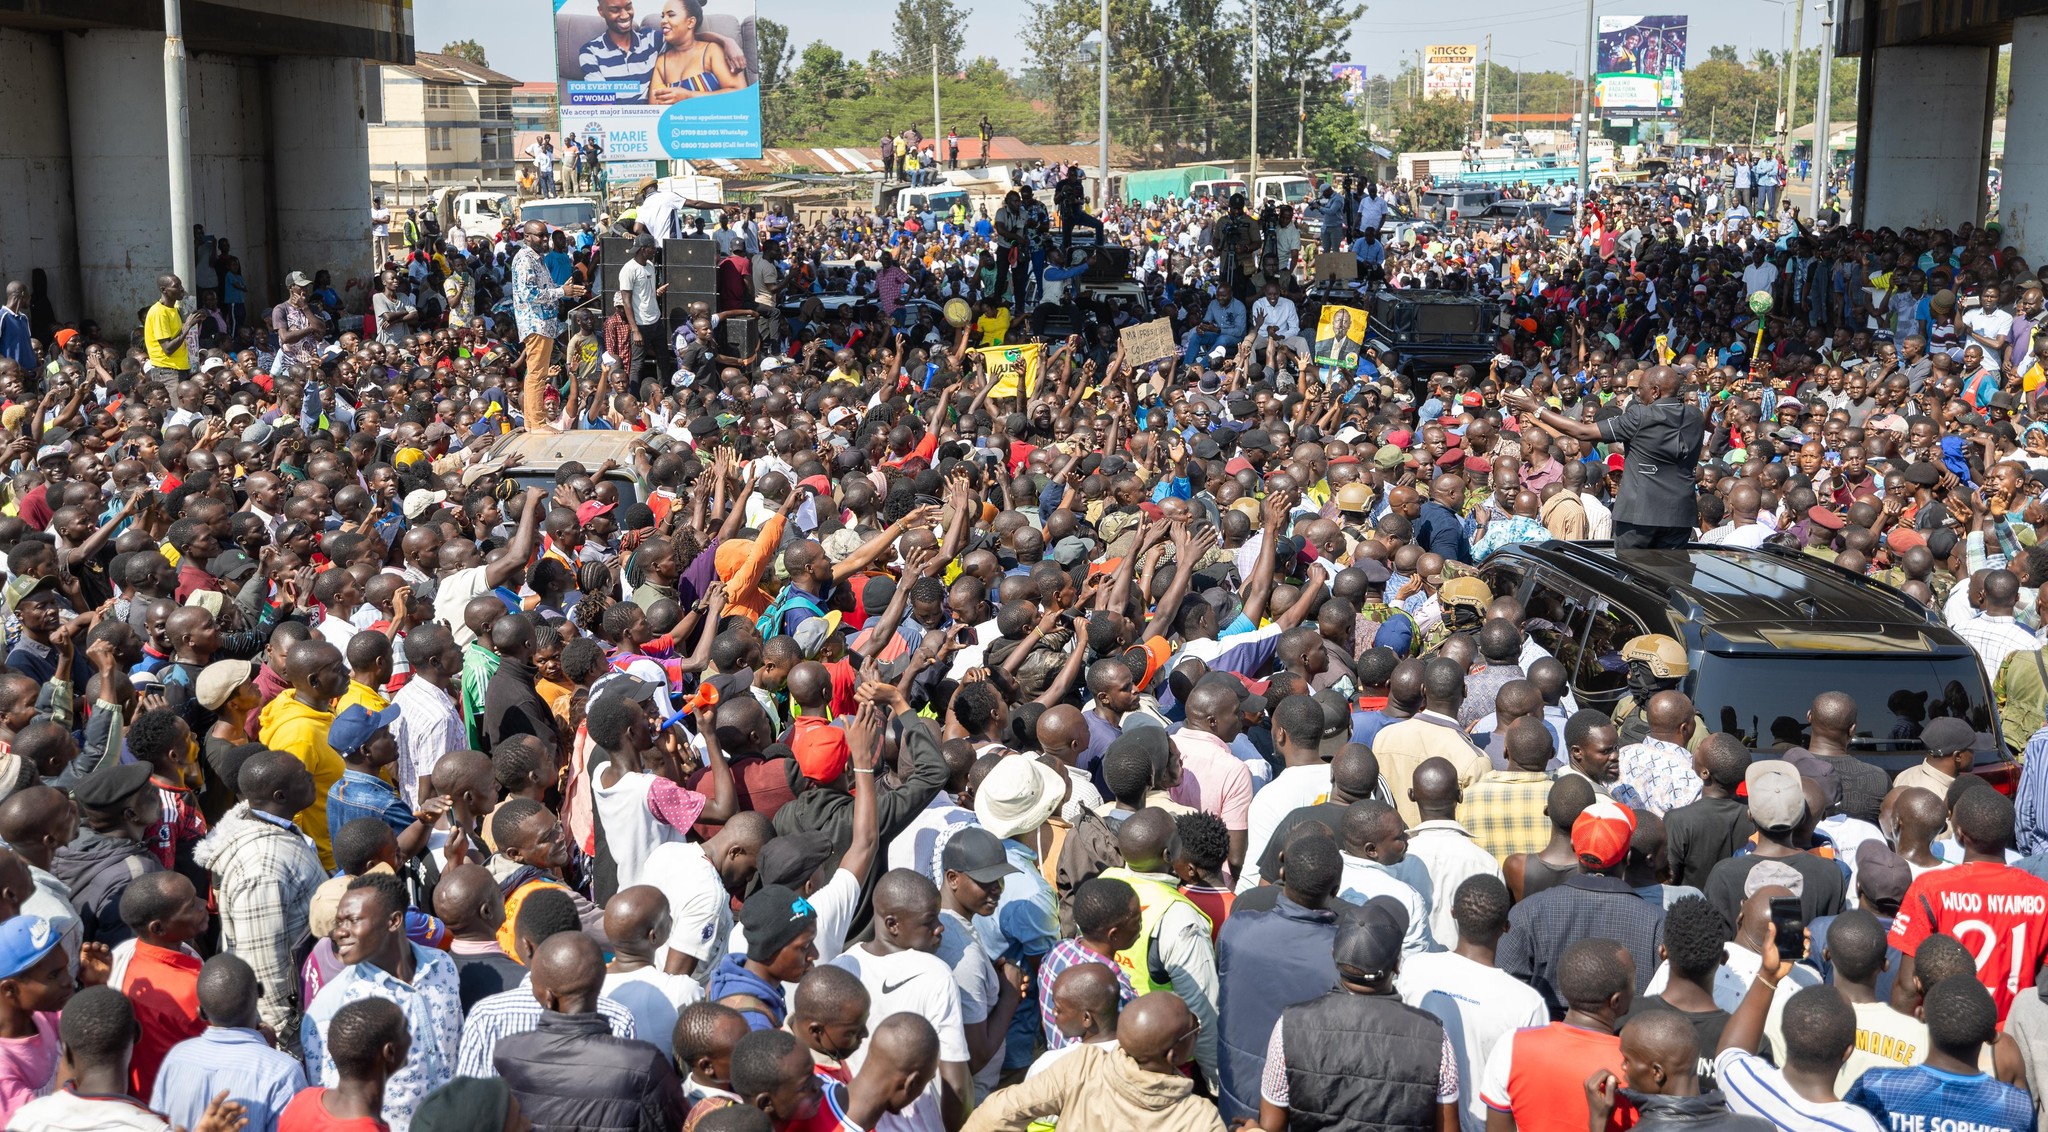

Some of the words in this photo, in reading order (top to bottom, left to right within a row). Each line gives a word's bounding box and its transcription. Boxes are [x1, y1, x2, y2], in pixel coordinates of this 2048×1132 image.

[570, 83, 586, 91] FOR
[588, 83, 613, 91] EVERY
[614, 83, 638, 91] STAGE
[561, 108, 573, 116] We
[600, 108, 620, 116] major
[610, 131, 648, 141] MARIE
[610, 143, 648, 153] STOPES
[723, 141, 736, 149] (Call
[1940, 891, 1982, 912] WUOD
[1987, 894, 2046, 916] NYAIMBO
[1889, 1111, 1926, 1132] THE
